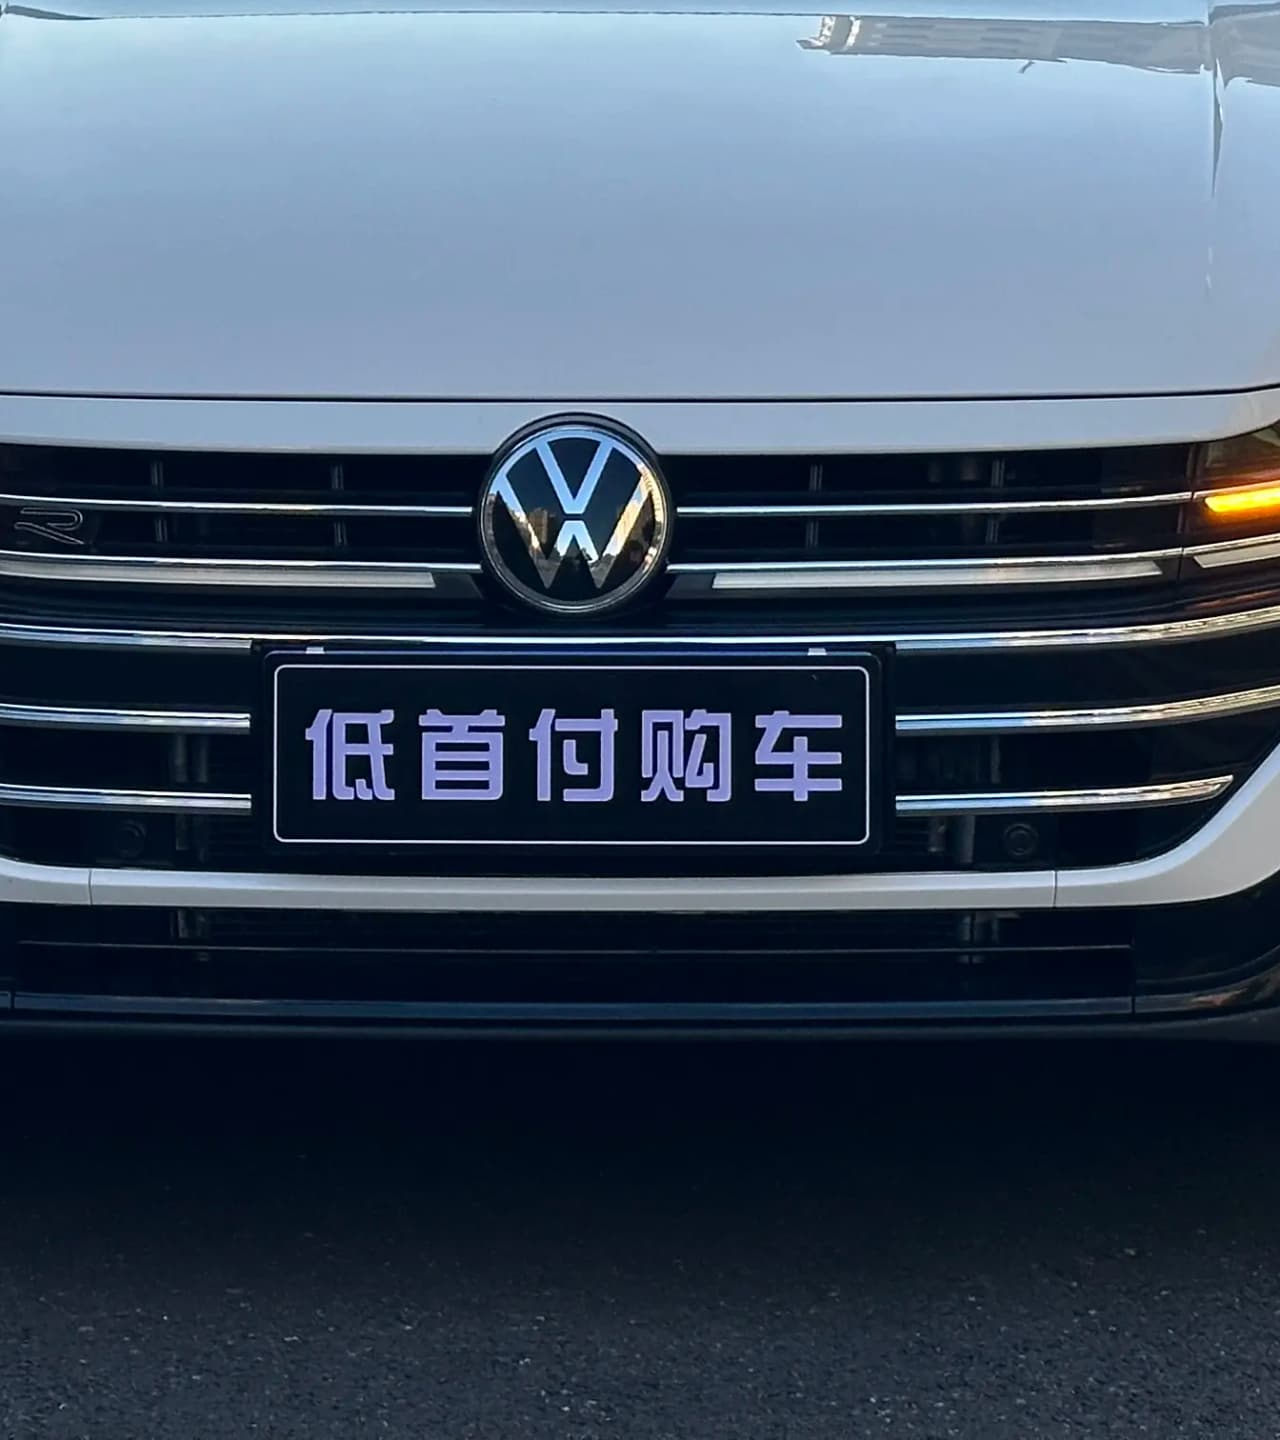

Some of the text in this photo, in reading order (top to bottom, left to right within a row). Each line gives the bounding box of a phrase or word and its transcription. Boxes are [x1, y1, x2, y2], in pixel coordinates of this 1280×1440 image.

[13, 506, 85, 545] R
[304, 707, 843, 802] 低首付购车
